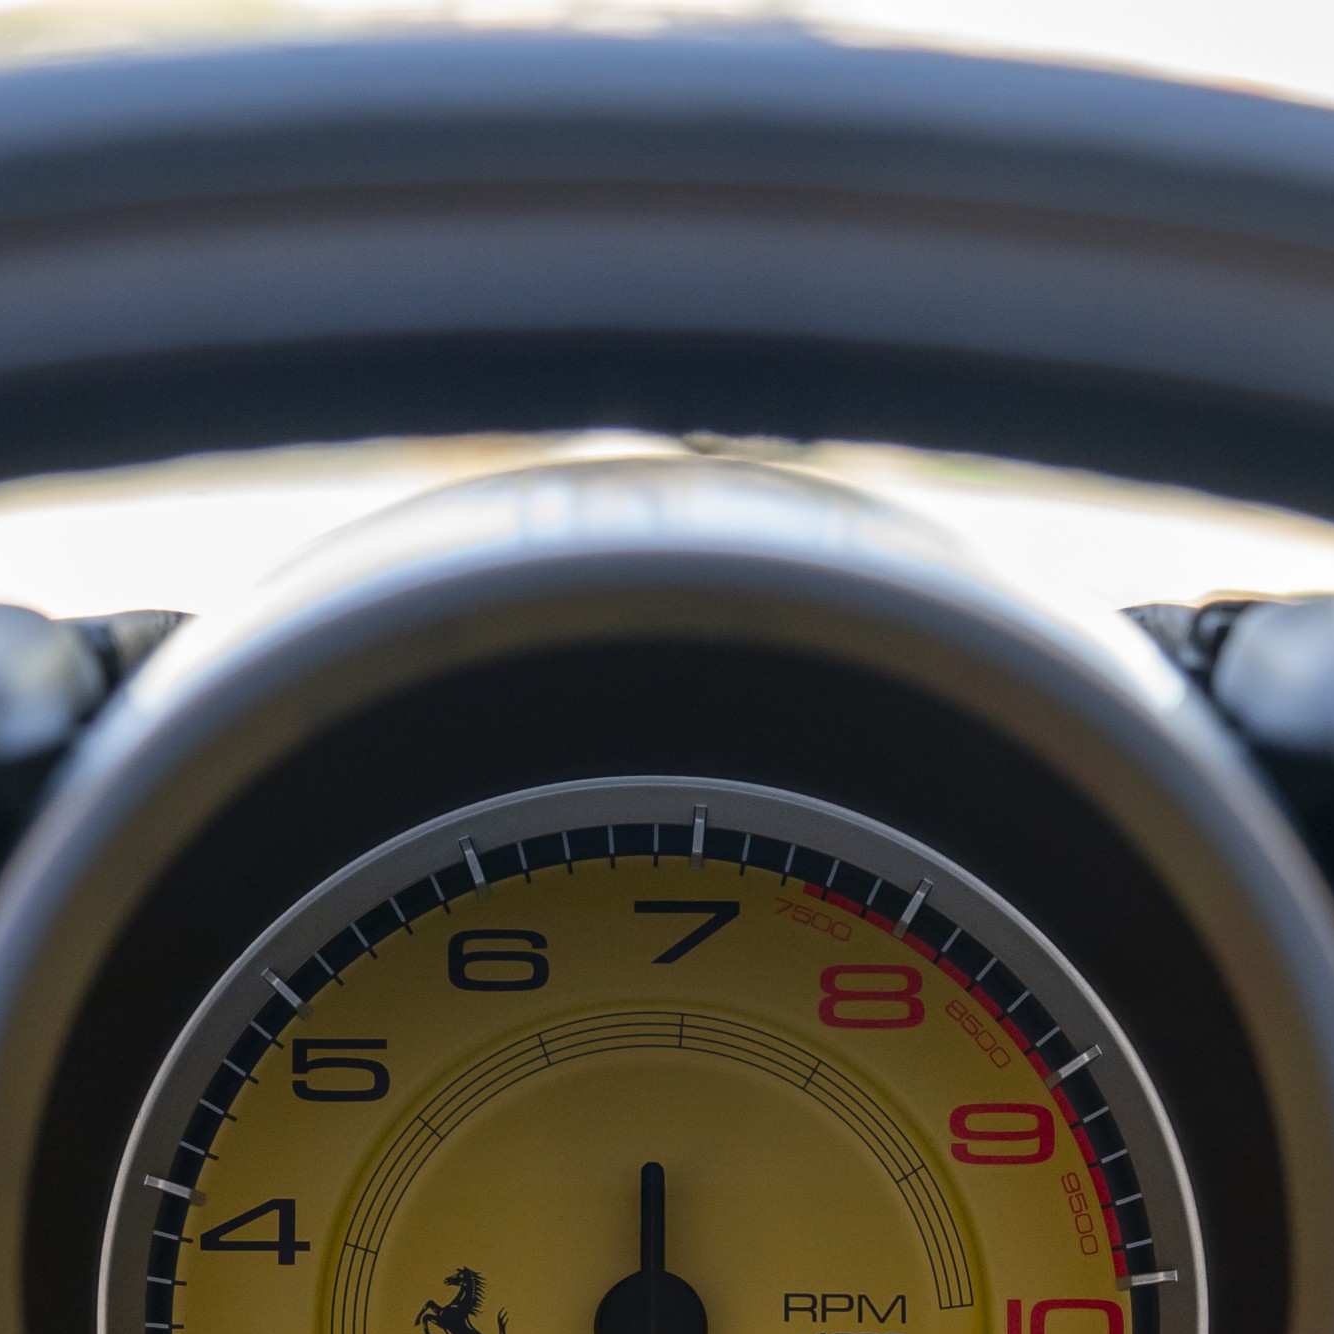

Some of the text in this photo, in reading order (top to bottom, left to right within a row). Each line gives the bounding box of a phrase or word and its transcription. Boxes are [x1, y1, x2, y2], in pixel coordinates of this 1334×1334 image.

[634, 901, 740, 964] 7
[774, 897, 852, 942] 7500
[448, 929, 549, 992] 6
[819, 964, 925, 1029] 8
[945, 1000, 1011, 1068] 8500
[292, 1039, 390, 1102] 5
[949, 1103, 1055, 1165] 9
[200, 1199, 310, 1265] 4
[1061, 1172, 1098, 1255] 9500
[784, 1293, 907, 1324] RPM
